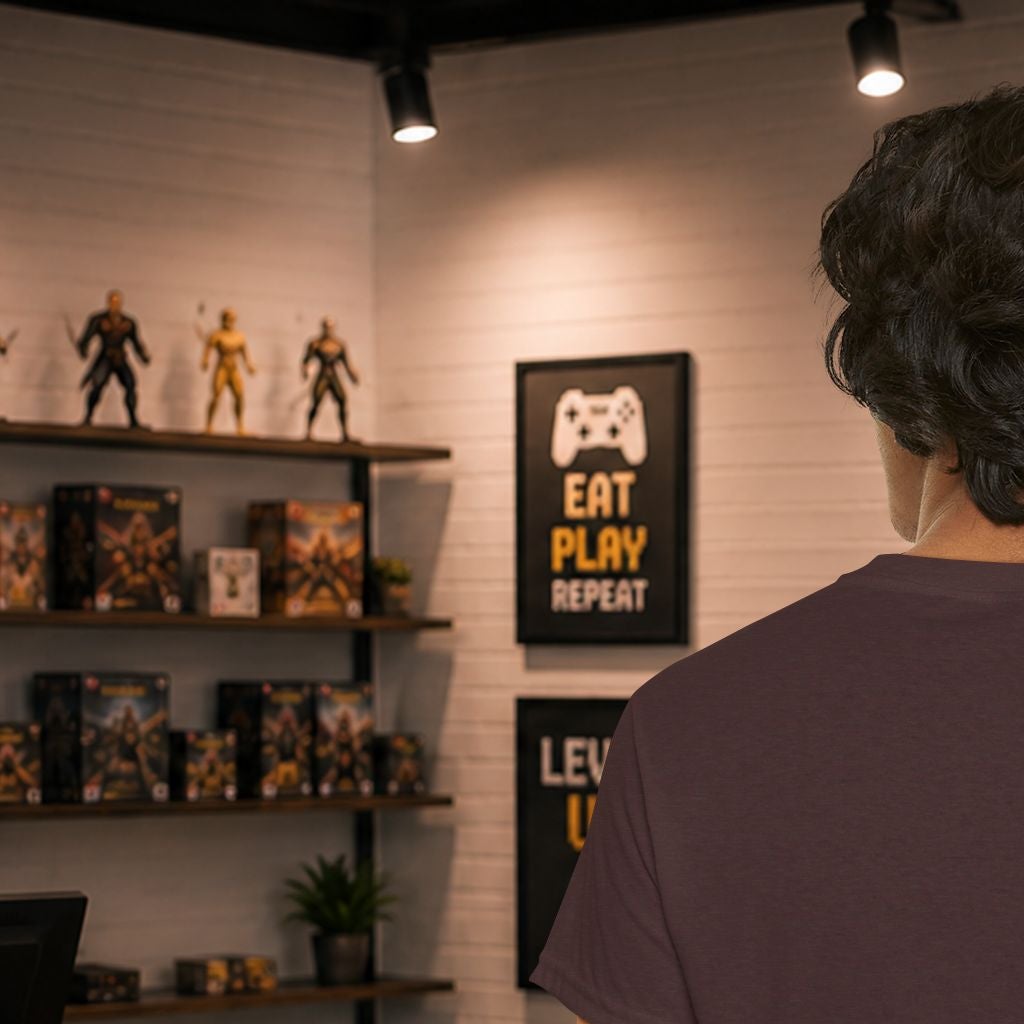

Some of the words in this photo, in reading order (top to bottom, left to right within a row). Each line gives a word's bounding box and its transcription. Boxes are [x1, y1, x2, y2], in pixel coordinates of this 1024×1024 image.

[563, 471, 637, 519] EAT
[551, 525, 648, 572] PLAY
[551, 578, 649, 612] REPEAT
